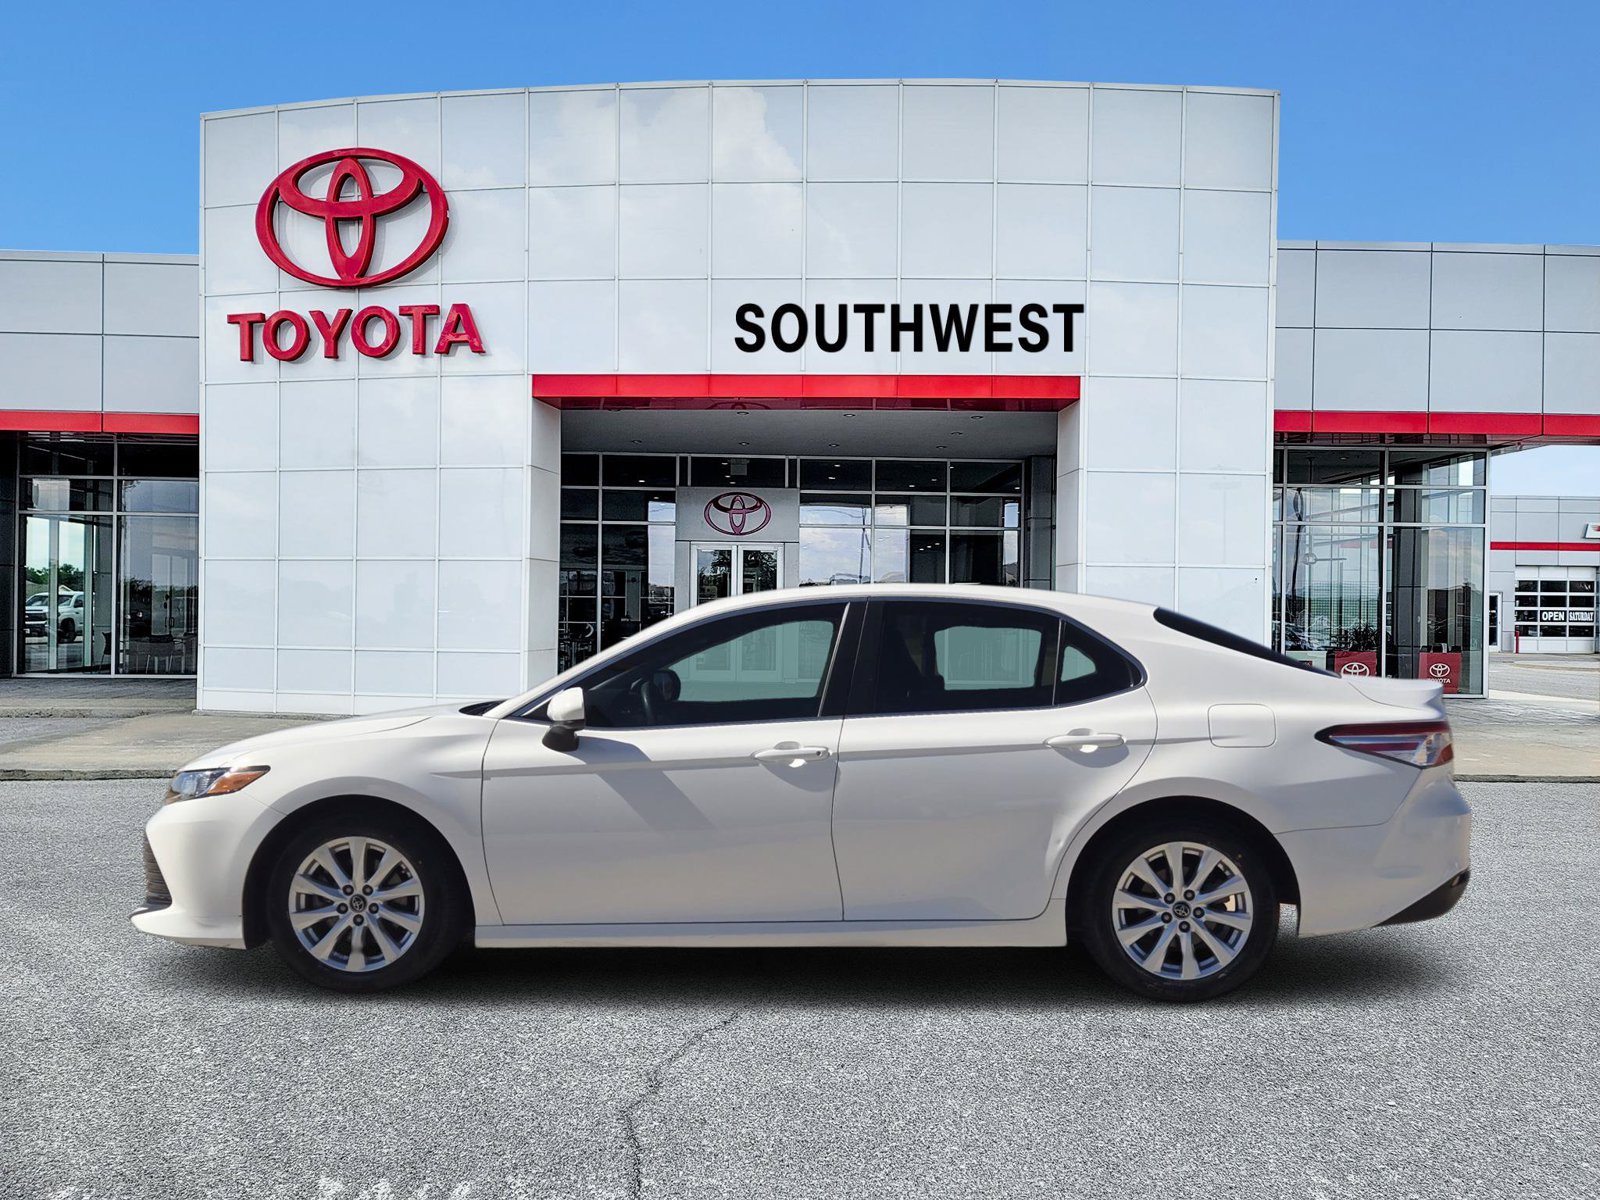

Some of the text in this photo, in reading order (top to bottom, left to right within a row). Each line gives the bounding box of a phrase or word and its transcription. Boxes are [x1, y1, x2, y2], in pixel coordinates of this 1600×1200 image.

[227, 303, 486, 362] TOYOTA
[734, 303, 1085, 353] SOUTHWEST
[1542, 611, 1565, 621] OPEN
